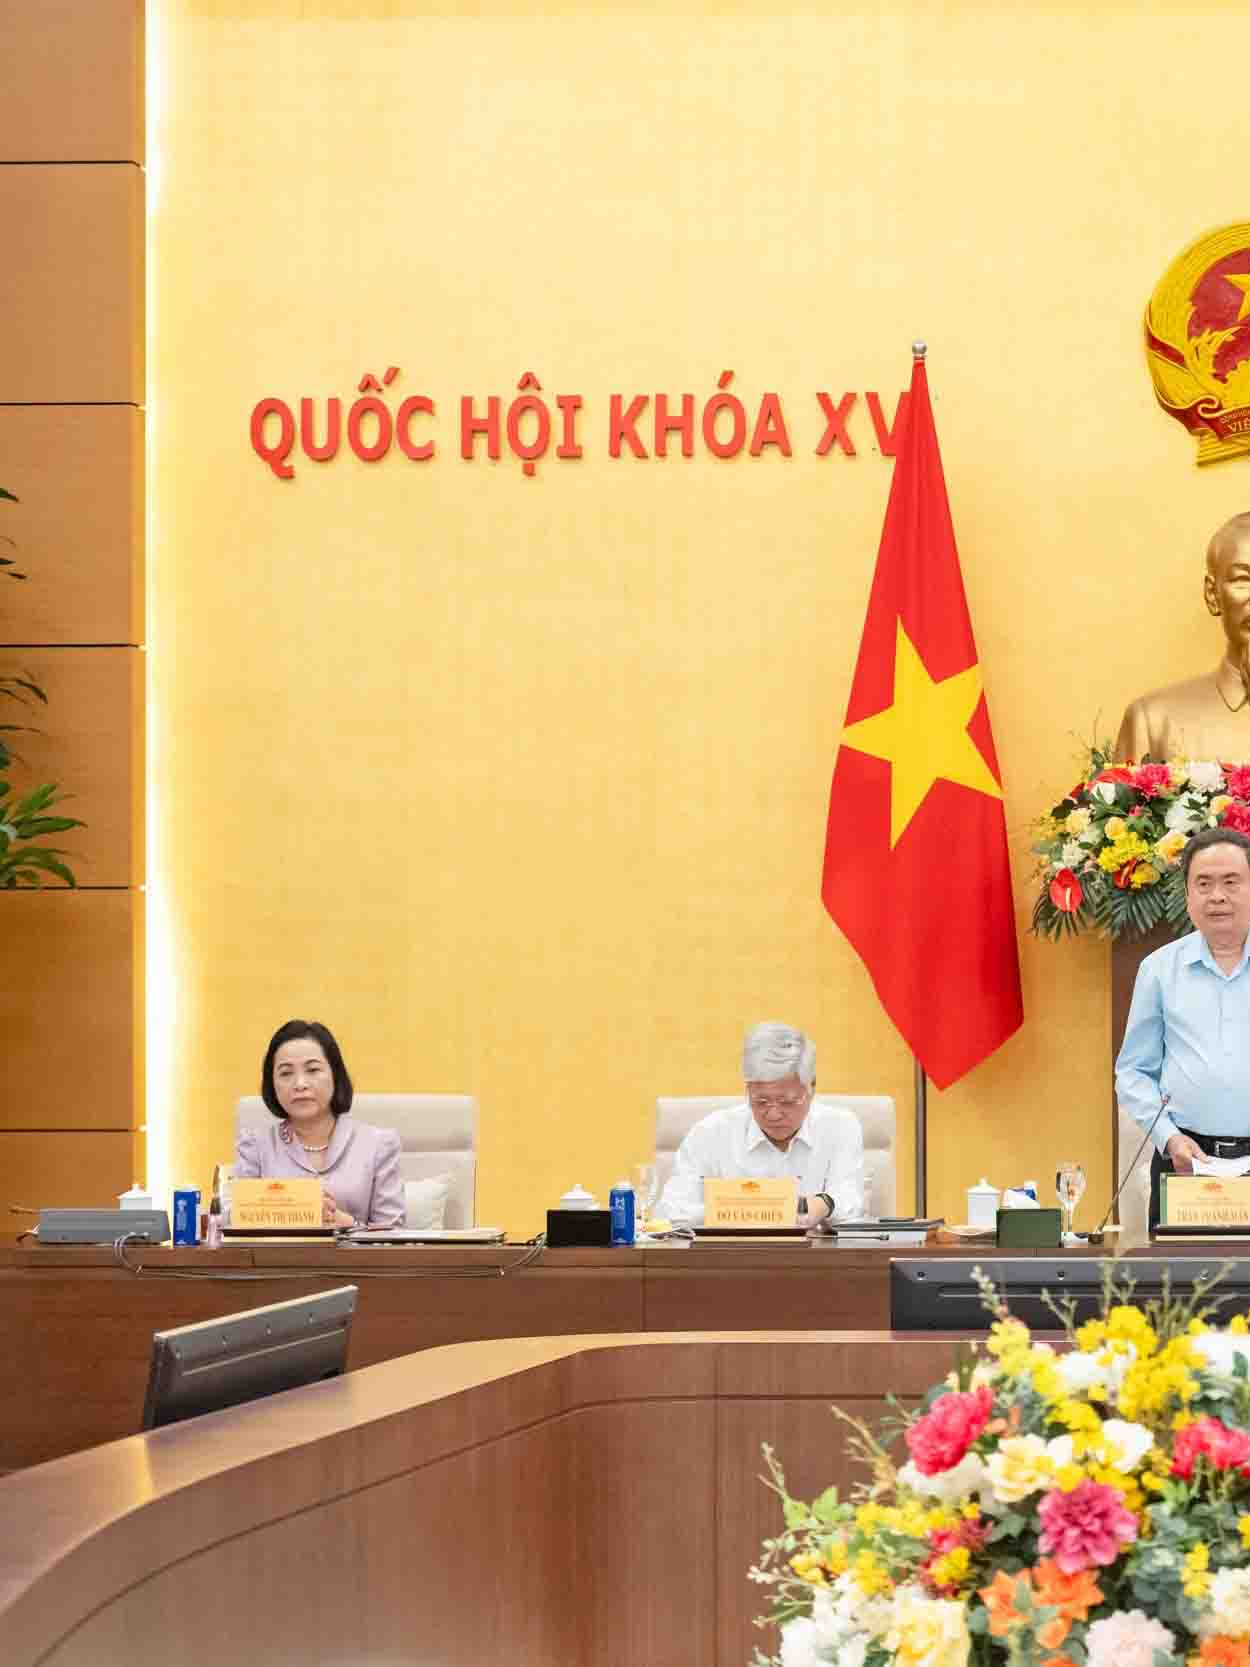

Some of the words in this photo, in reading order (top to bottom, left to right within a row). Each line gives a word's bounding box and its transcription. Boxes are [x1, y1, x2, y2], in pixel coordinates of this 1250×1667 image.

[250, 367, 435, 480] QUỐC
[460, 372, 583, 477] HỘI
[607, 371, 793, 459] KHÓA
[815, 391, 912, 457] XV
